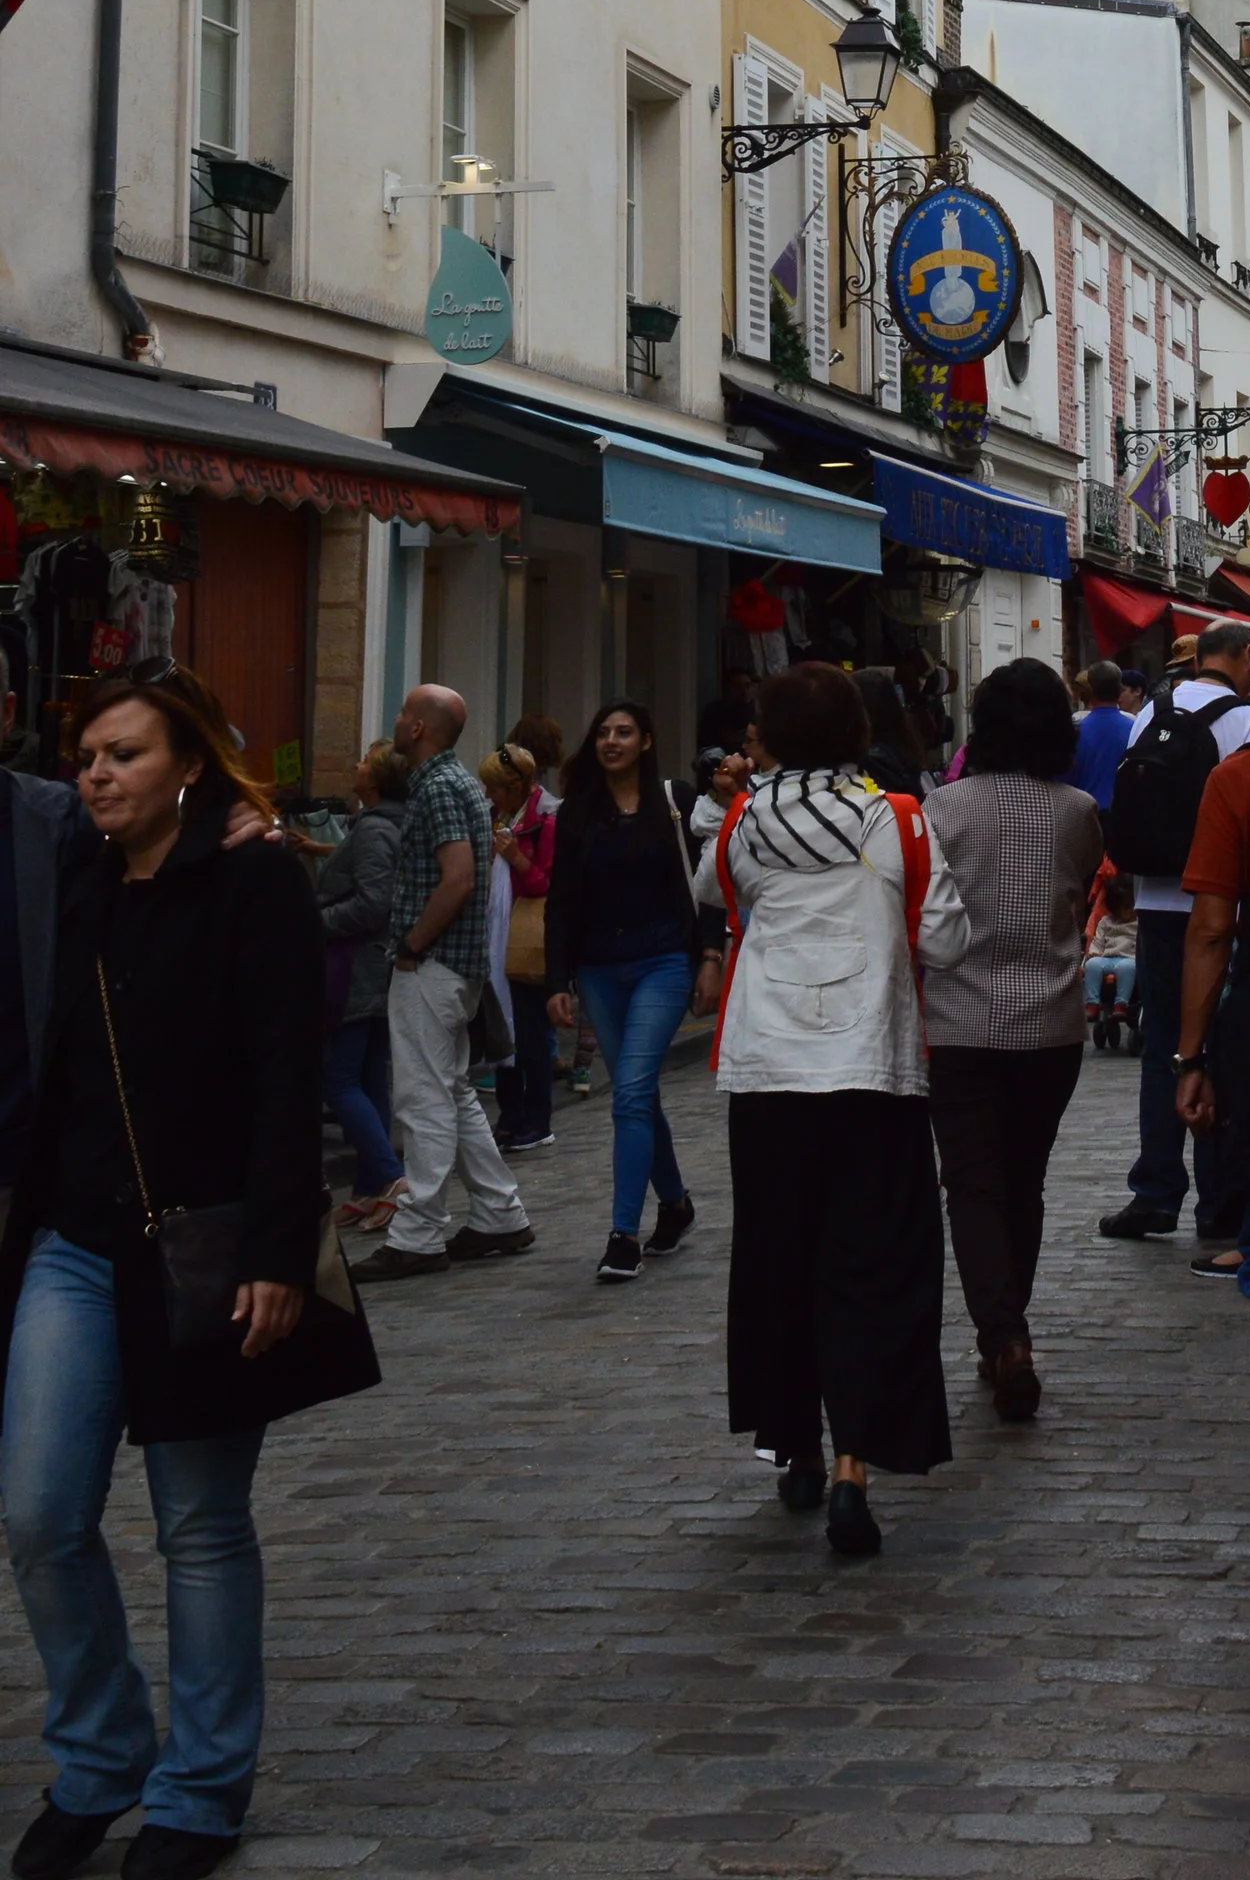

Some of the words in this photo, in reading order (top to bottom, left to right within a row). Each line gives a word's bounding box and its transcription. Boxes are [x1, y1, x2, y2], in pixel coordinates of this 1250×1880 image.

[431, 292, 462, 317] La
[464, 297, 505, 327] goutte
[443, 332, 460, 351] de
[460, 331, 494, 351] lait
[142, 440, 222, 483] SACRE
[227, 453, 298, 493] COEUR
[308, 470, 415, 511] SOUVENIRS
